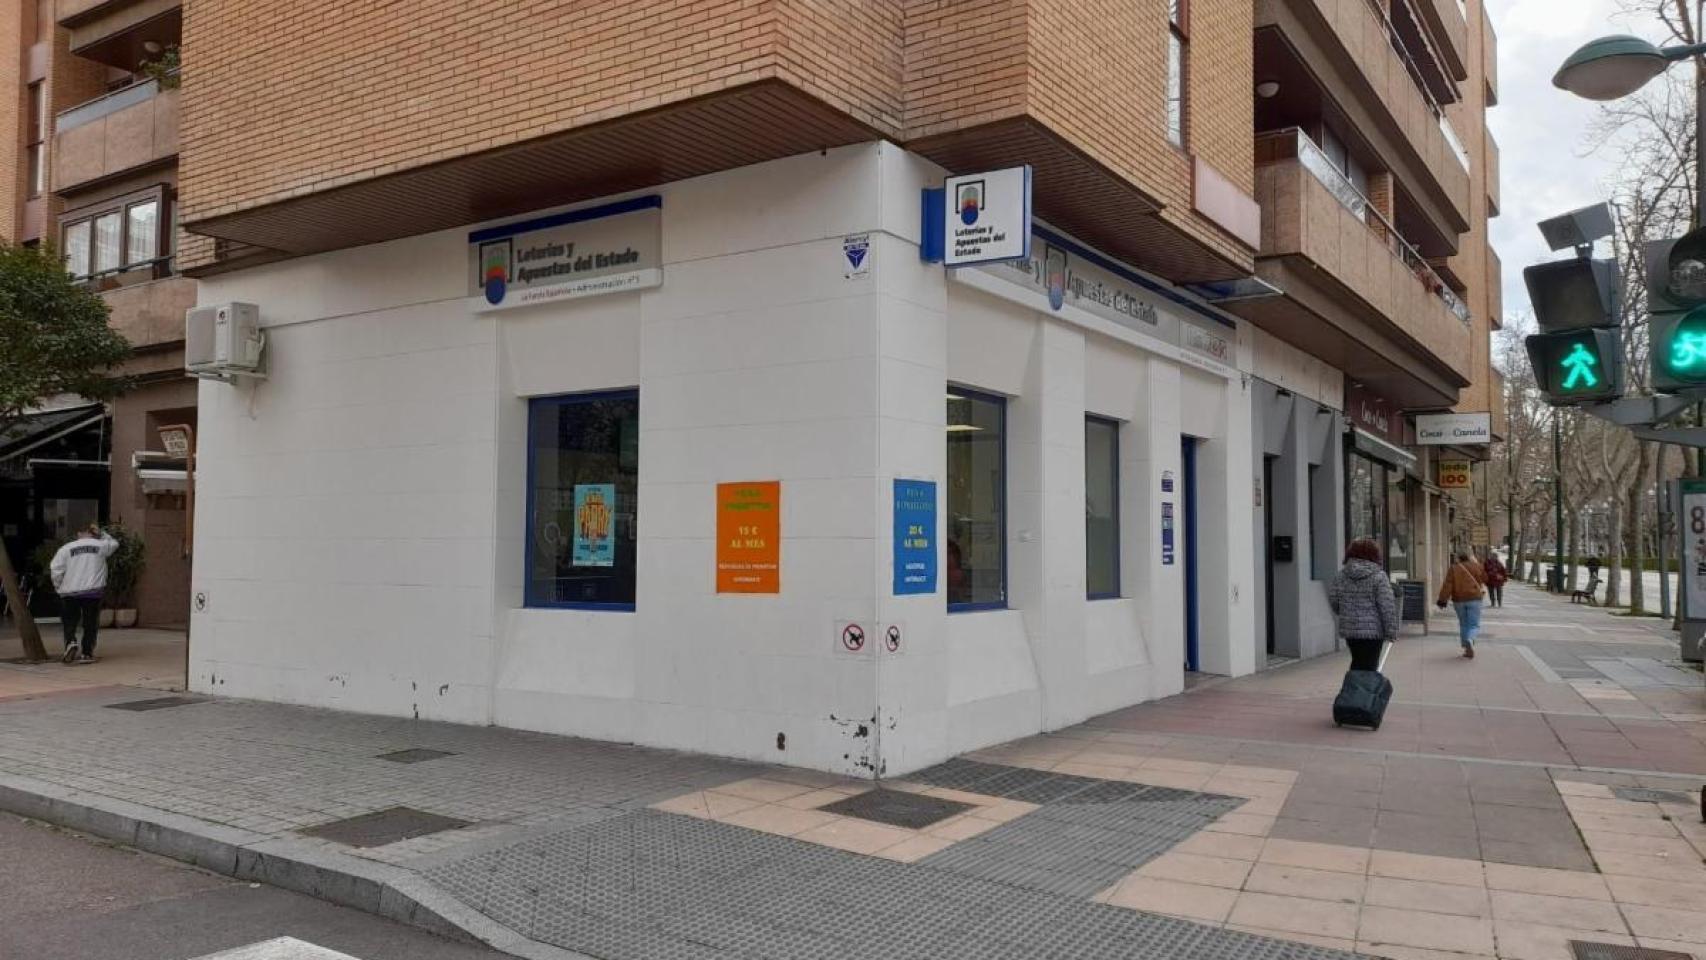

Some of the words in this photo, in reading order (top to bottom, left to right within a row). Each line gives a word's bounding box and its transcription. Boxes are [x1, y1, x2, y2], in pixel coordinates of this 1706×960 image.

[988, 225, 994, 234] y
[955, 236, 991, 247] Apuestas
[993, 232, 1006, 241] del
[566, 242, 576, 258] y
[955, 248, 981, 257] Estado
[517, 262, 571, 284] Apuestas
[574, 255, 593, 272] del
[595, 247, 639, 269] Estado
[1441, 474, 1467, 484] 100
